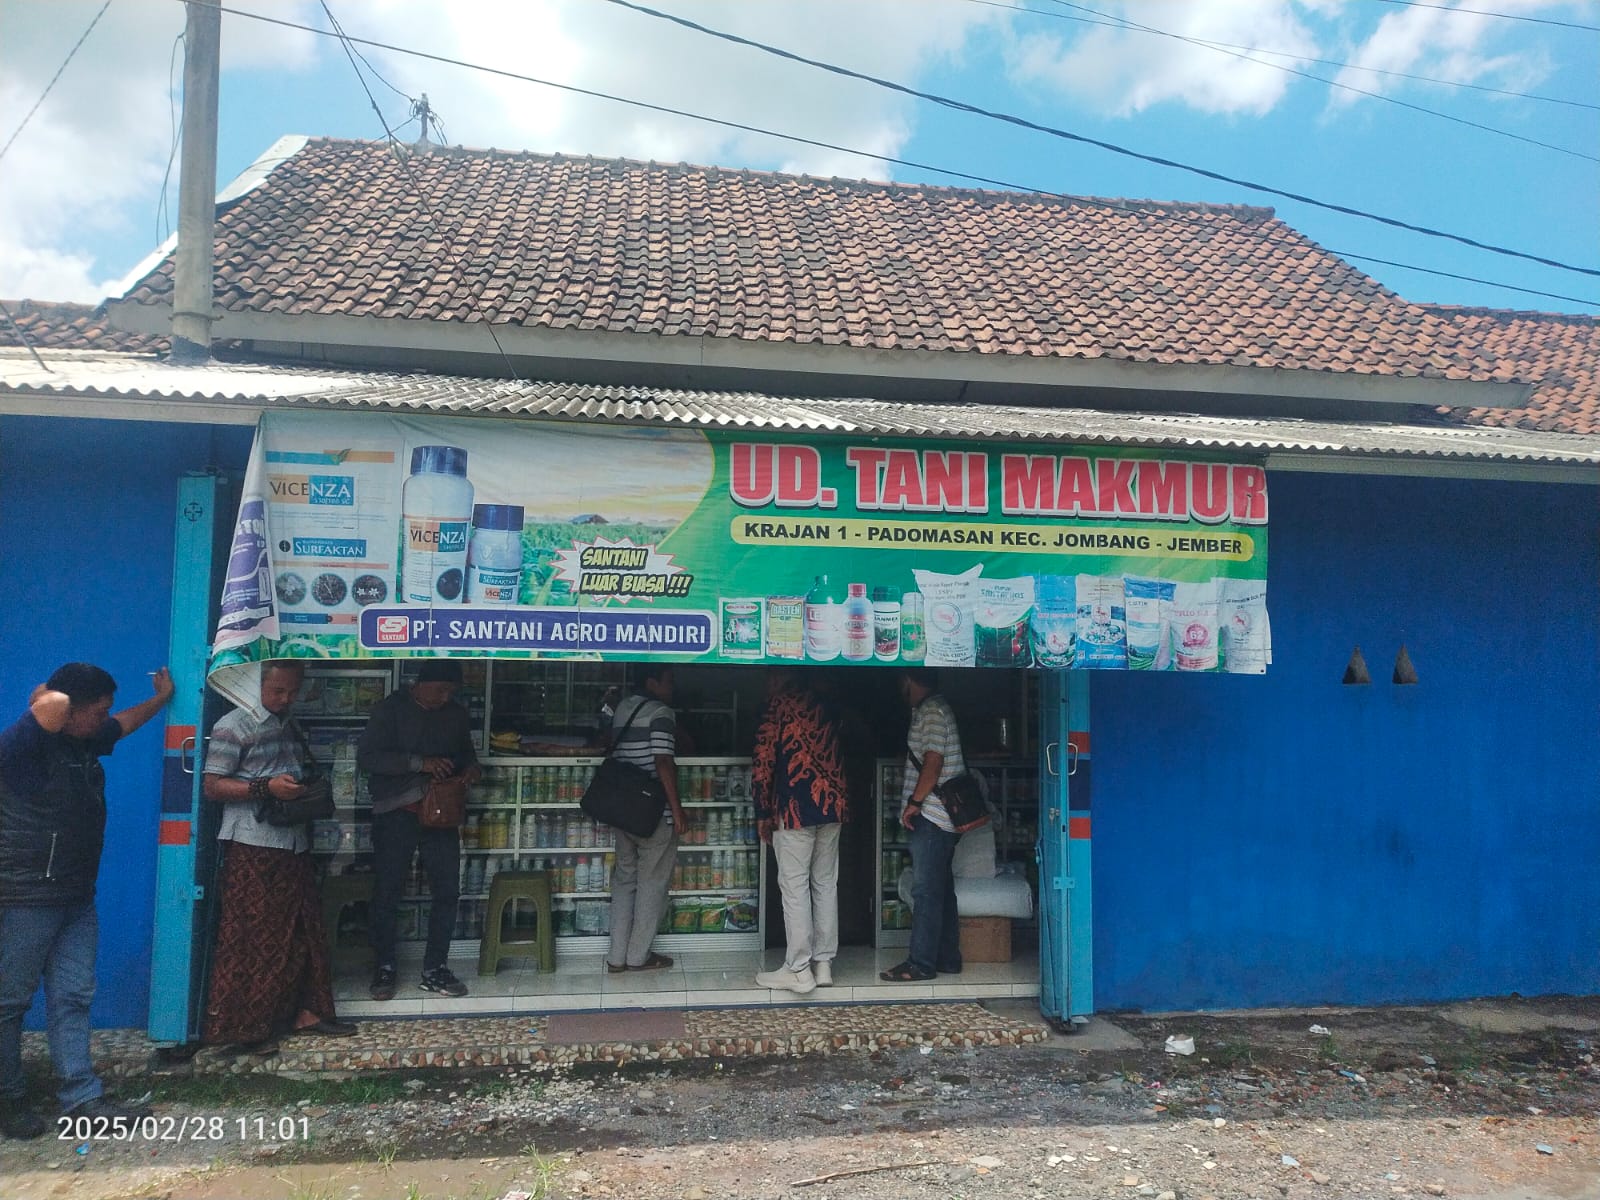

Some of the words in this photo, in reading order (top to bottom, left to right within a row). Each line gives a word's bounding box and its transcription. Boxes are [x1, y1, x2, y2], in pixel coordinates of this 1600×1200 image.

[269, 481, 351, 498] VICENZA
[730, 443, 838, 509] UD.
[846, 446, 989, 515] TANI
[1001, 454, 1269, 525] MAKMUR
[410, 529, 465, 544] VICENZA
[744, 522, 830, 540] KRAJAN
[837, 526, 848, 540] 1
[867, 526, 994, 545] PADOMASAN
[1000, 531, 1047, 547] KEC.
[1053, 533, 1151, 551] JOMBANG
[1167, 538, 1243, 554] JEMBER
[295, 541, 364, 556] SURFAKTAN
[581, 547, 648, 570] SANTANI
[580, 573, 619, 595] LUAR
[621, 574, 667, 596] BIASA
[667, 574, 694, 598] !!!
[382, 633, 406, 641] SANTANI
[413, 620, 440, 639] PT.
[449, 620, 543, 641] SANTANI
[550, 621, 608, 642] AGRO
[615, 623, 706, 644] MANDIRI
